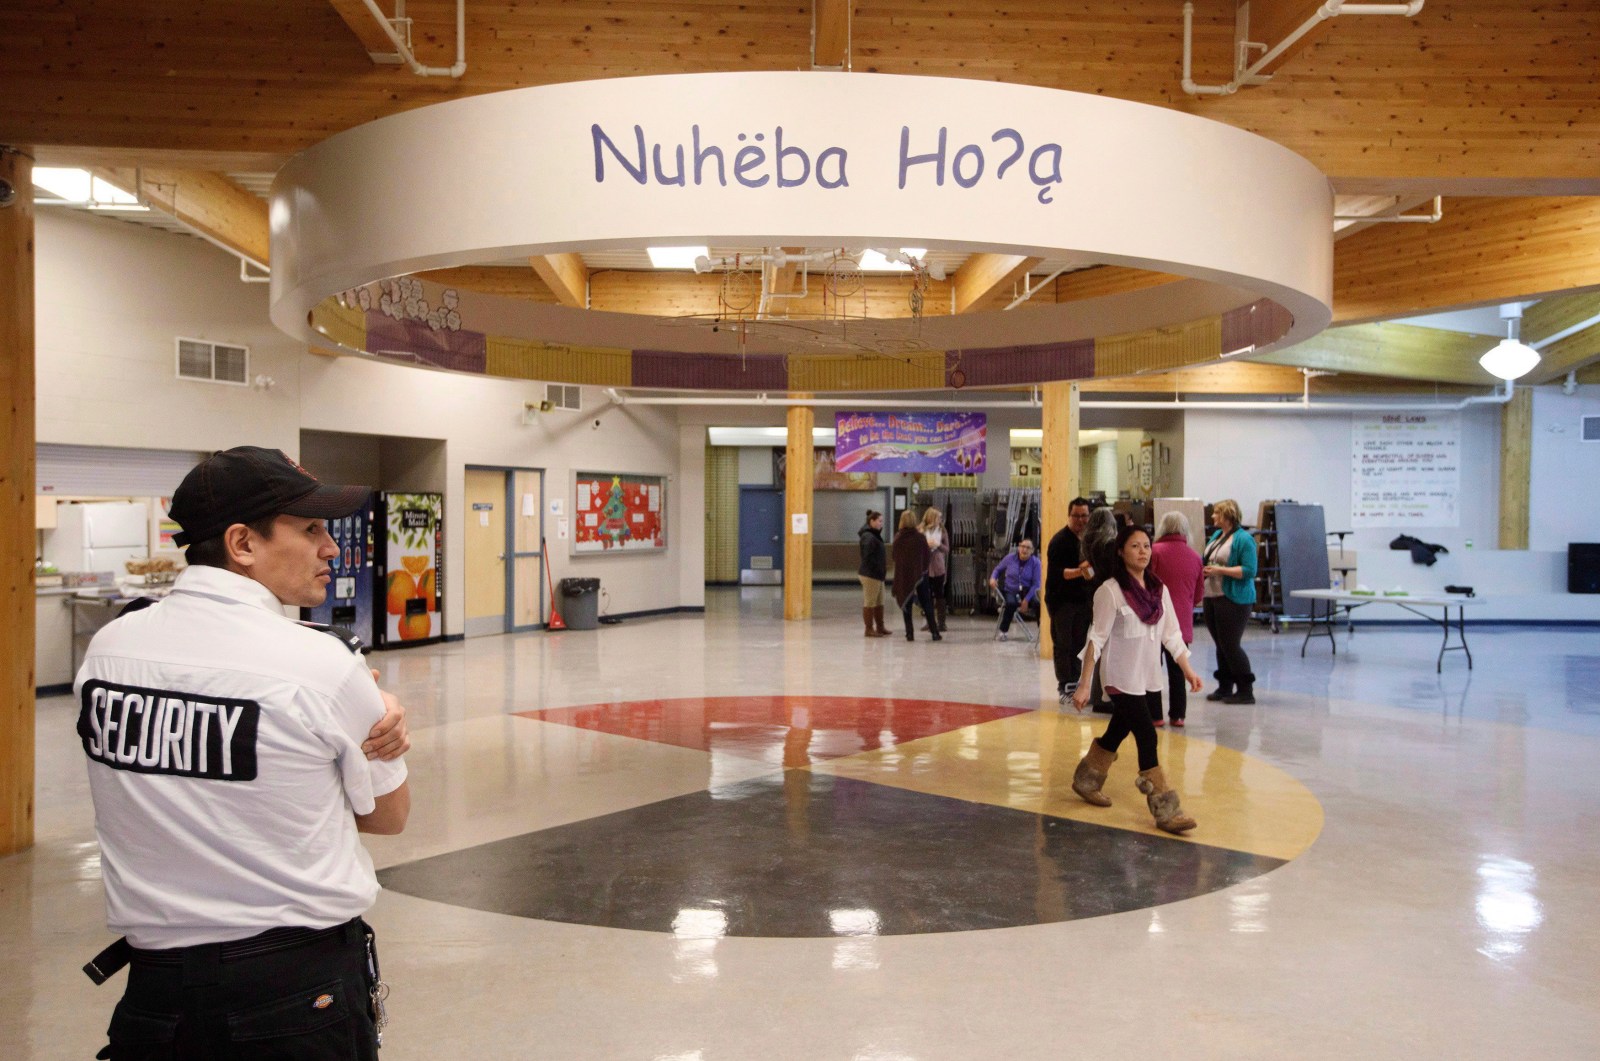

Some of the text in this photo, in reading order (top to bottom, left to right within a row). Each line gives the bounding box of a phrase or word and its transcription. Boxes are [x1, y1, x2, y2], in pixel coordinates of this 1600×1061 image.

[591, 123, 850, 188] Nuhëba
[838, 414, 886, 437] Believe...
[888, 415, 934, 433] Dream...
[914, 436, 928, 444] you
[405, 511, 427, 519] Minute
[88, 687, 244, 774] SECURITY
